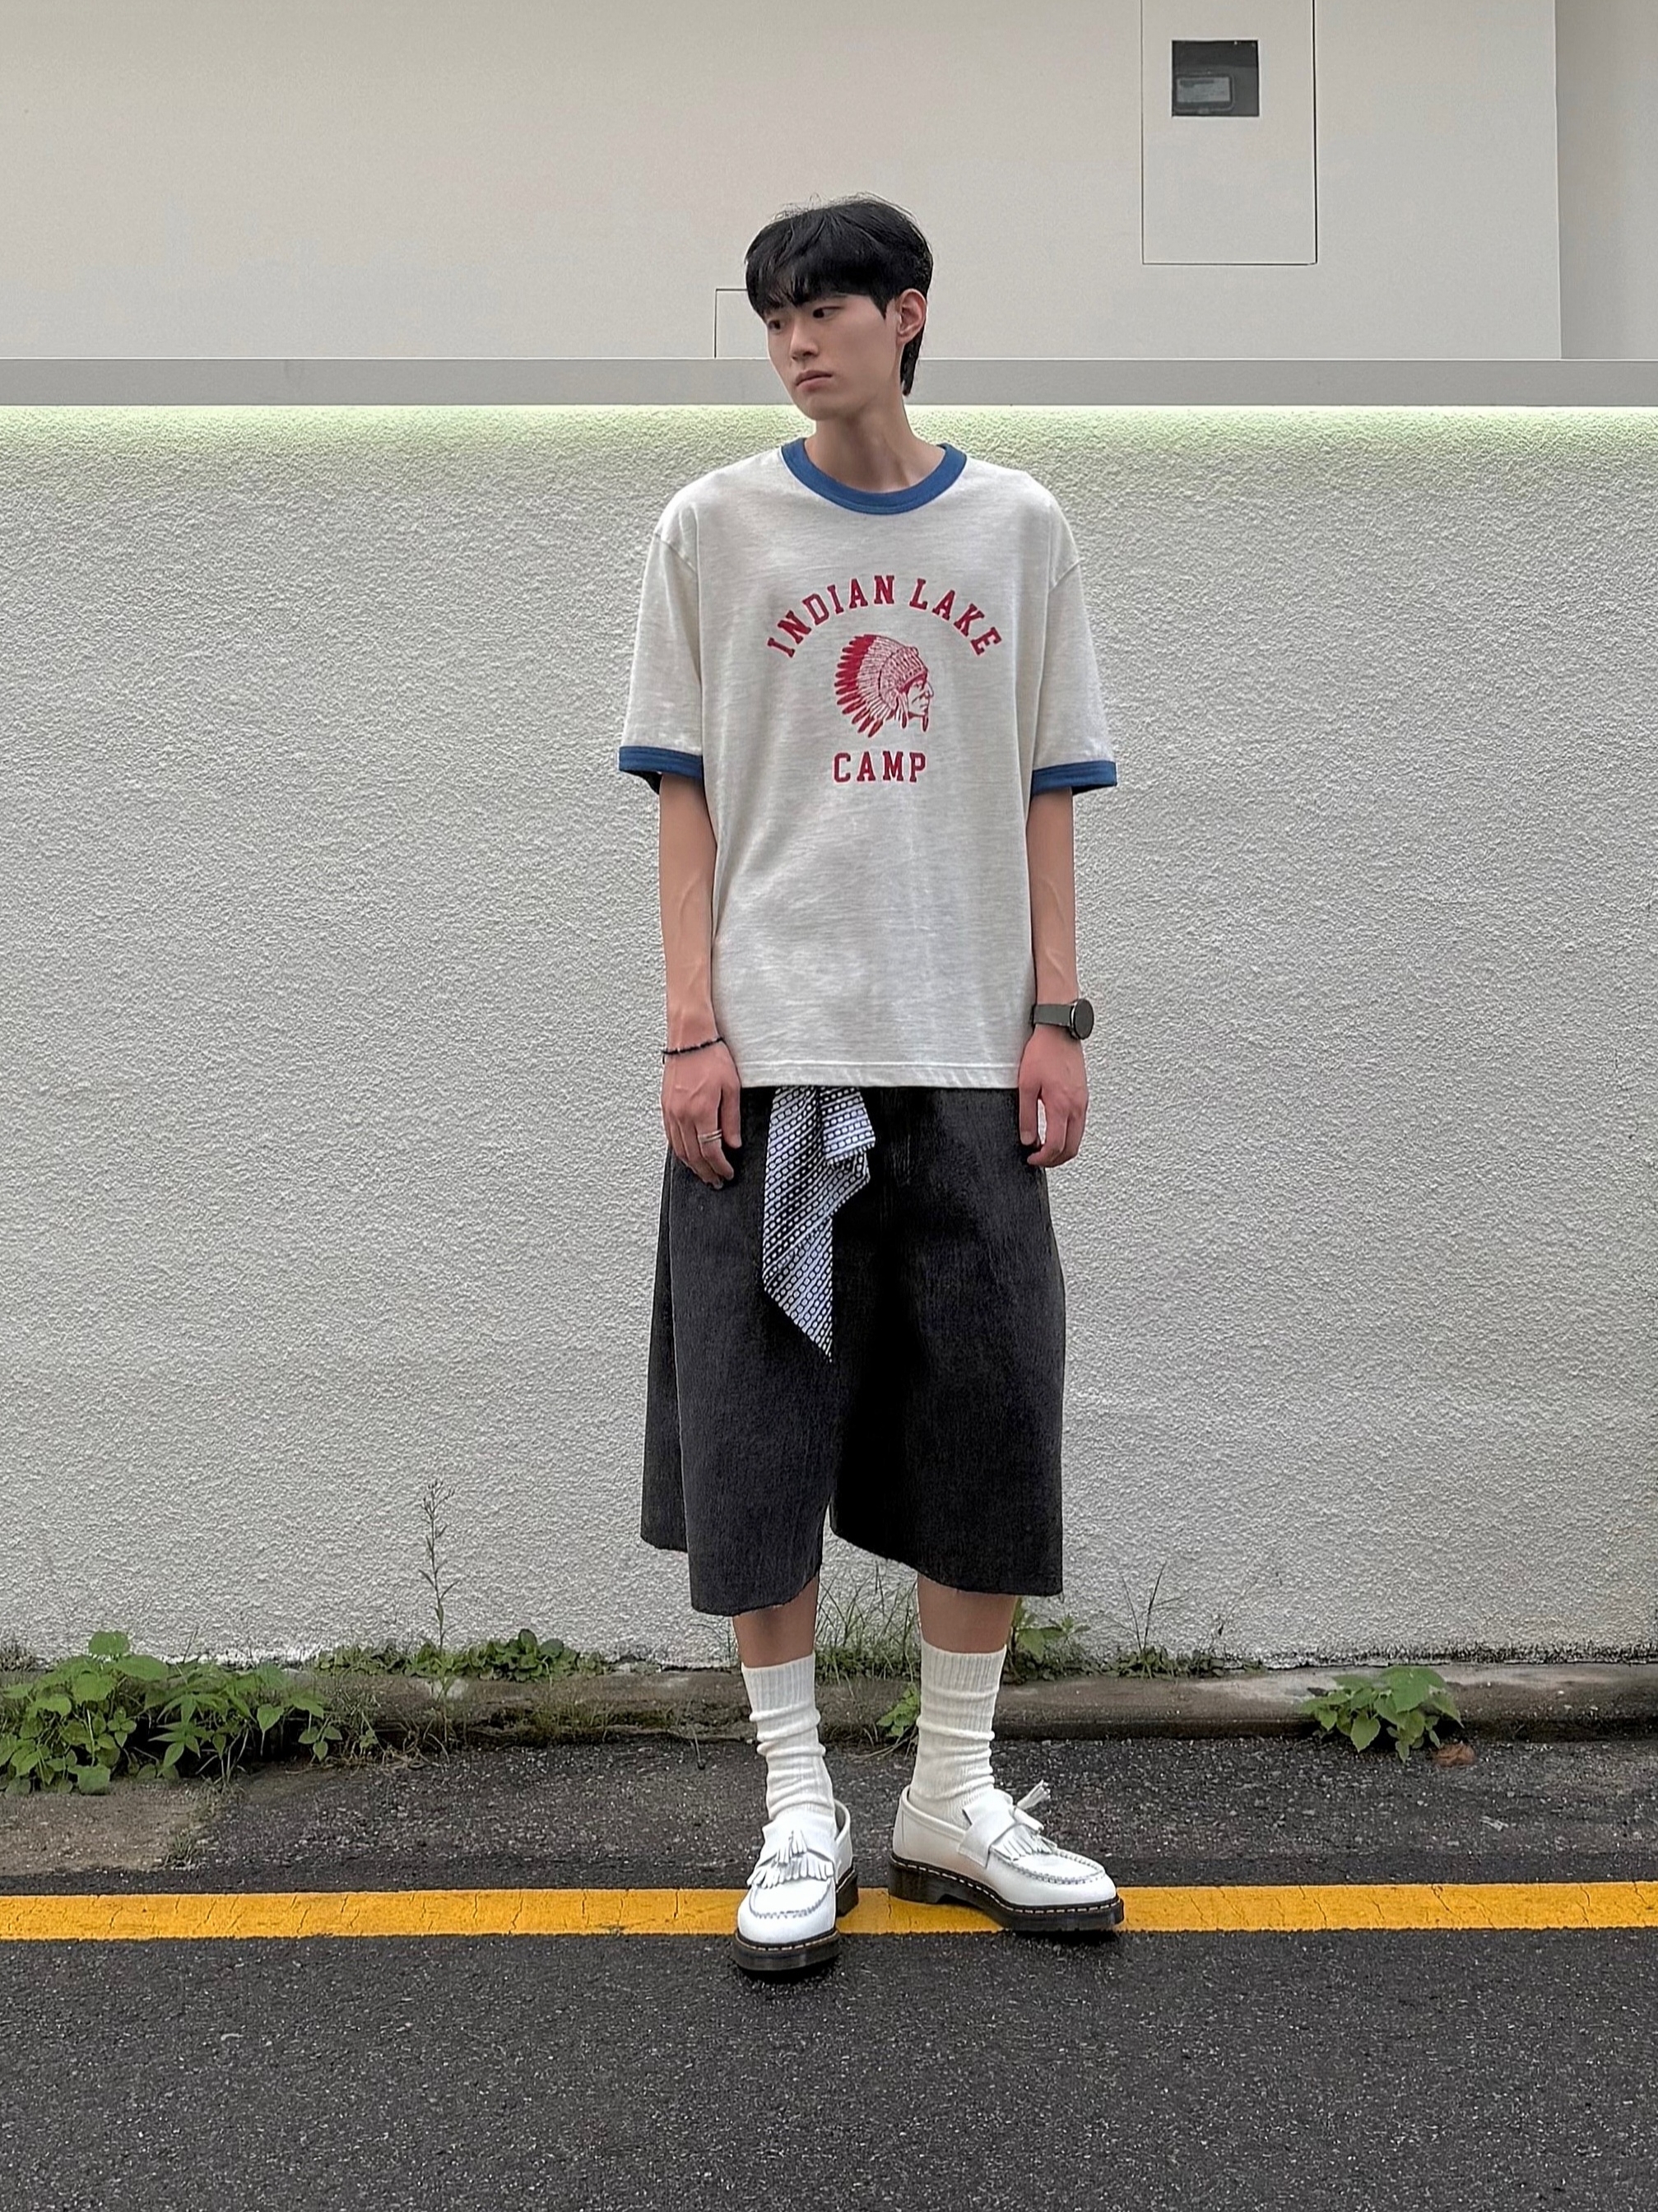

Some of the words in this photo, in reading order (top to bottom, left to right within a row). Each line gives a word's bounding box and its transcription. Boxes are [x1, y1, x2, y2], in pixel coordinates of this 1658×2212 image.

[767, 575, 894, 658] INDIAN
[909, 579, 1002, 655] LAKE
[834, 750, 927, 783] CAMP
